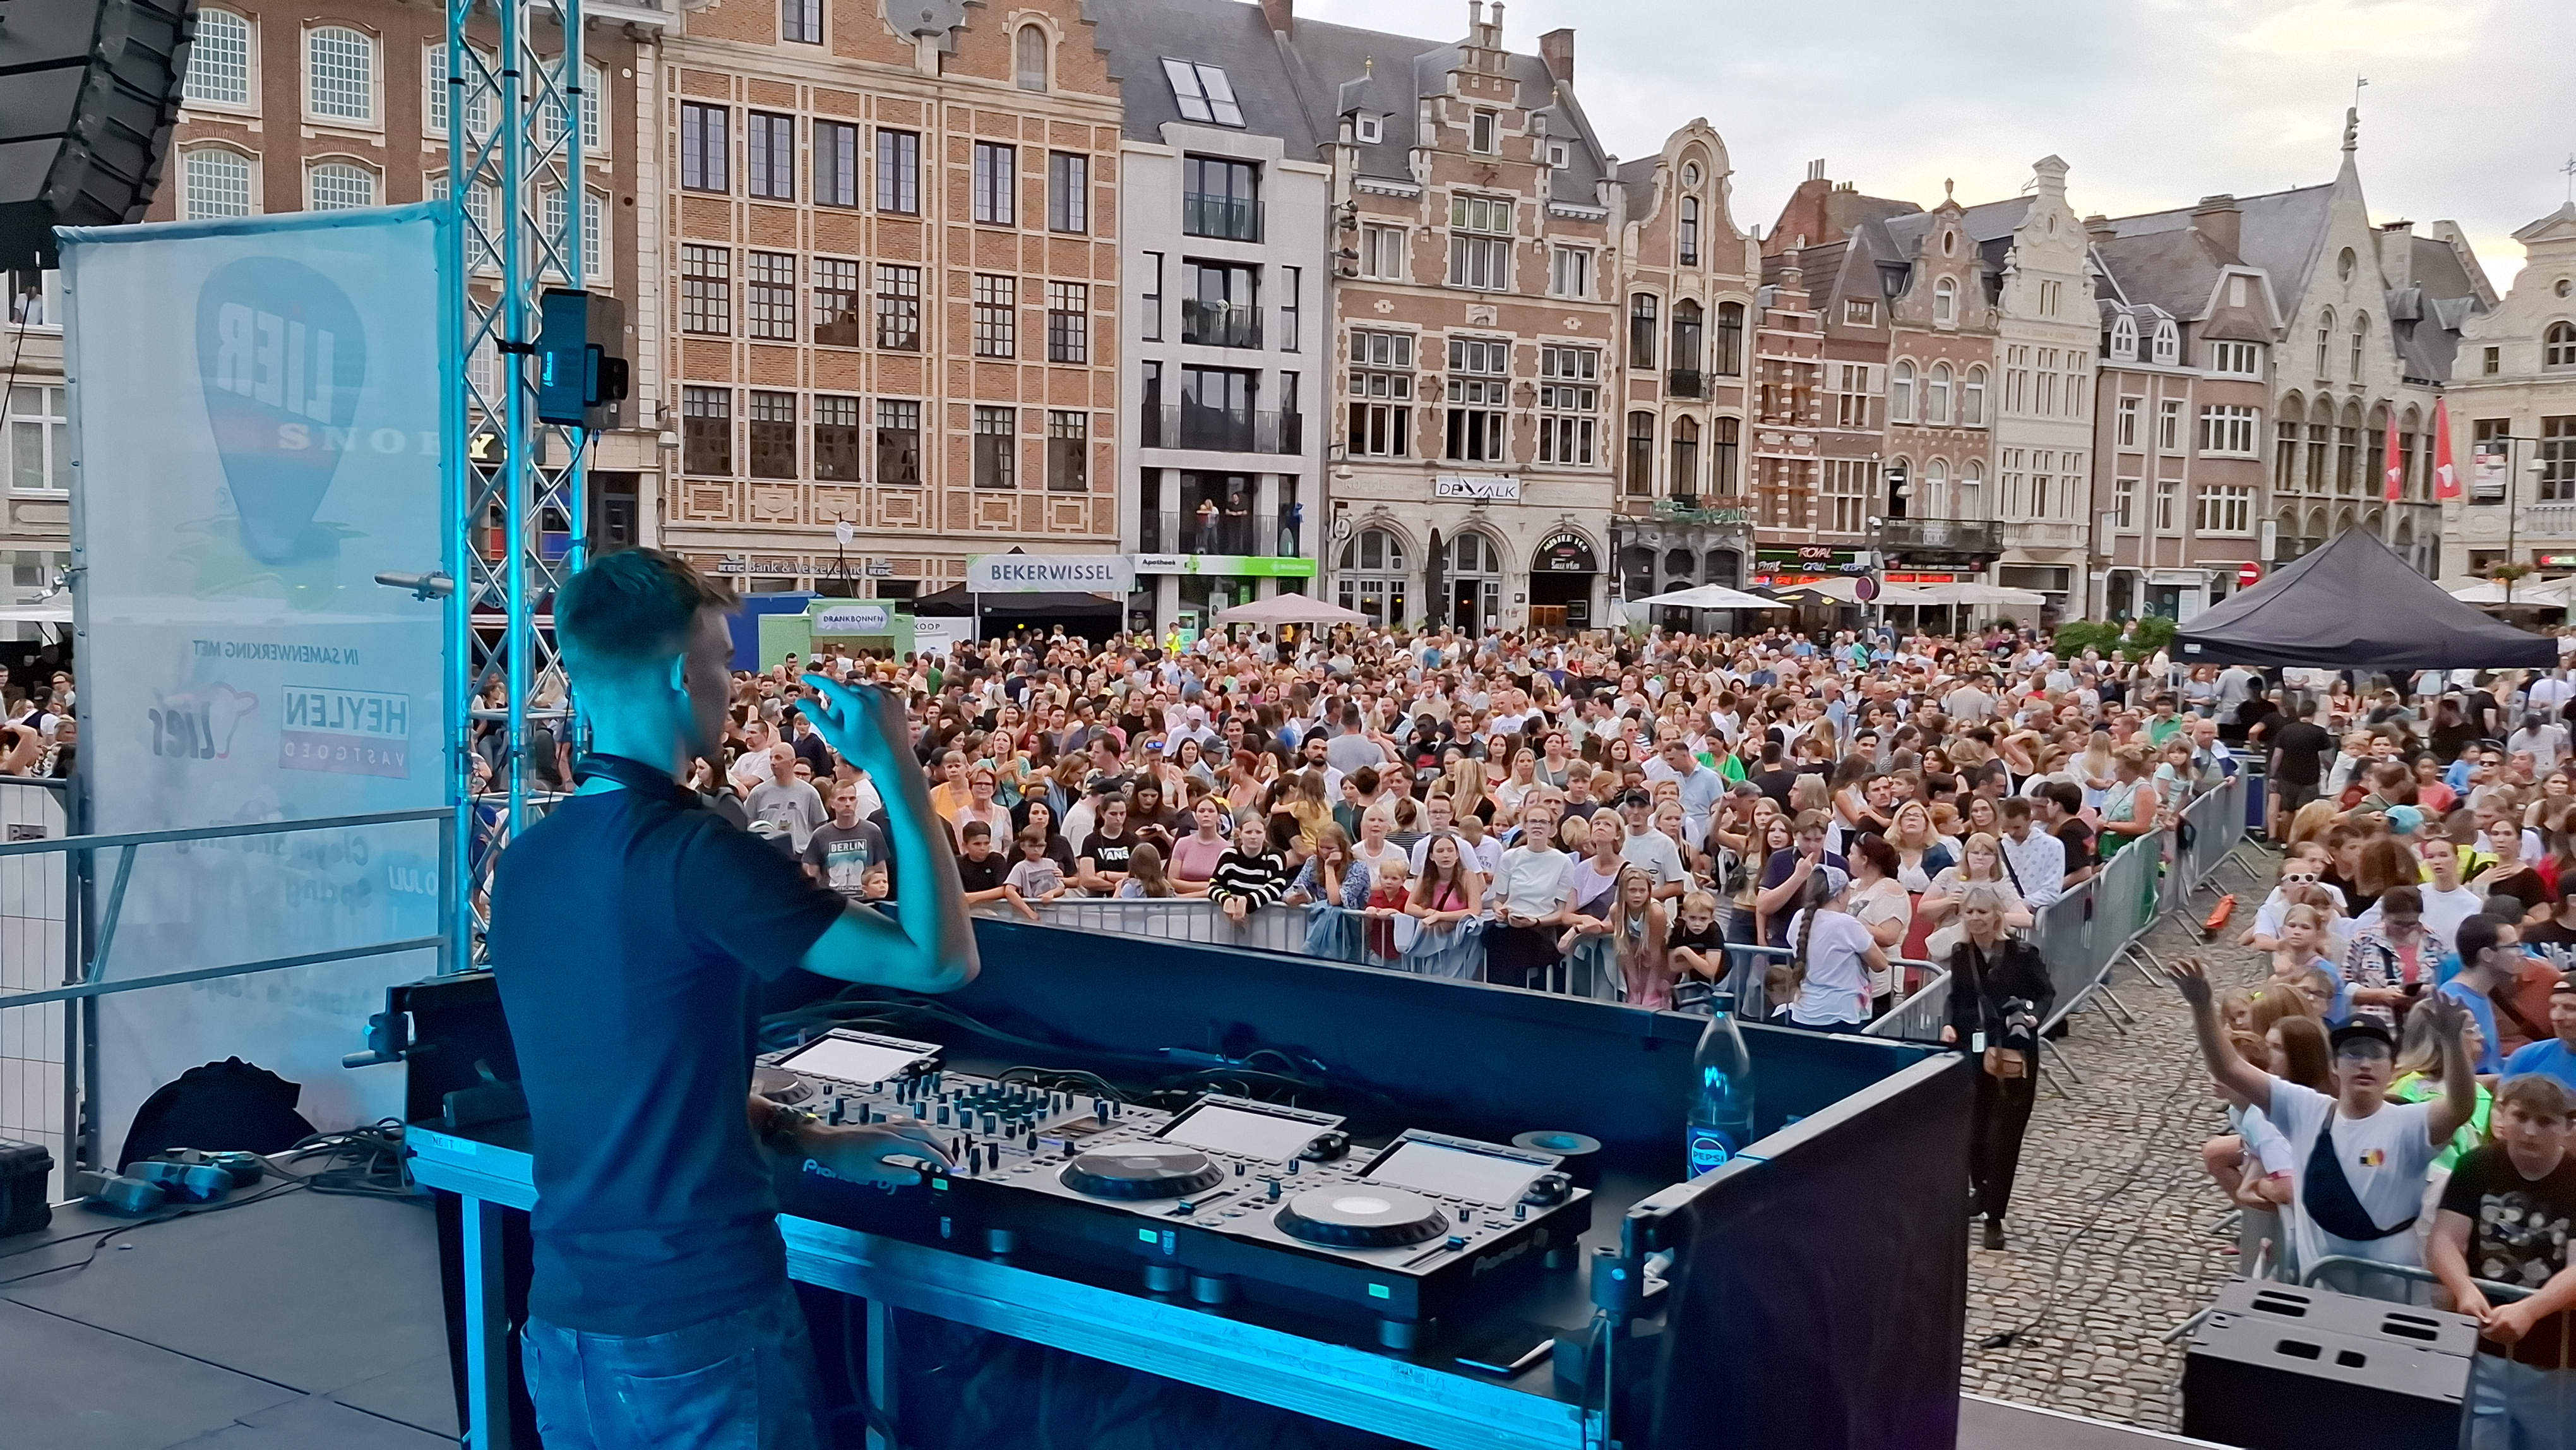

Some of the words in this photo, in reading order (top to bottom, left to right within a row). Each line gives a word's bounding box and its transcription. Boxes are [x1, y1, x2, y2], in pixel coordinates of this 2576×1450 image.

[1798, 547, 1832, 558] ROYAL
[749, 560, 778, 572] Bank
[782, 561, 790, 573] &
[1142, 558, 1176, 566] Apotheek
[991, 565, 1113, 580] BEKERWISSEL
[831, 841, 864, 853] BERLIN
[1097, 846, 1129, 860] VANS
[1693, 1151, 1724, 1163] PEPSI
